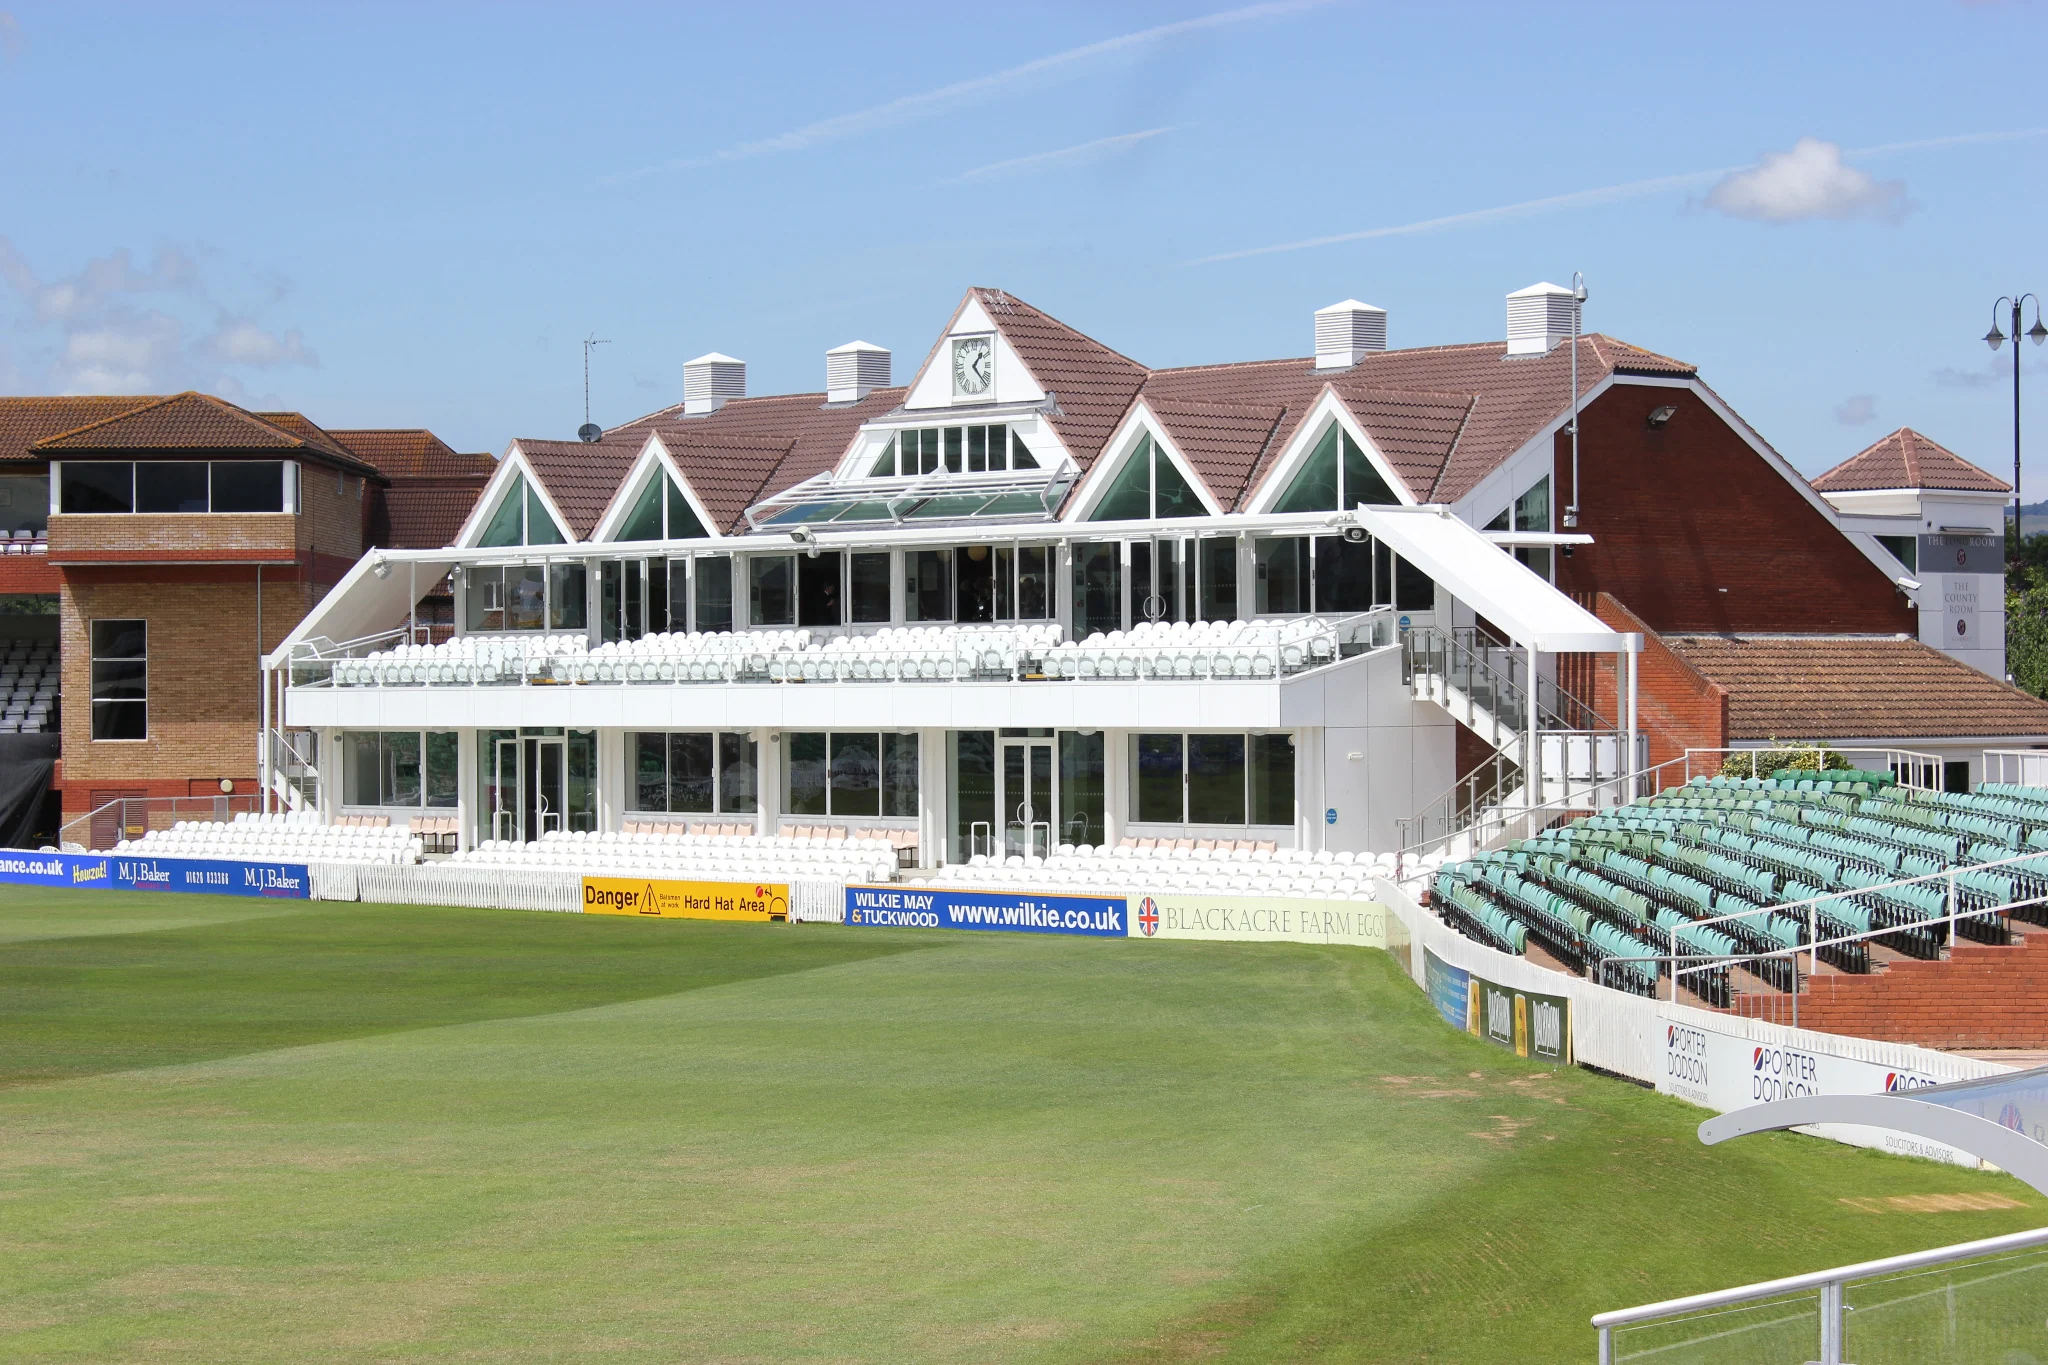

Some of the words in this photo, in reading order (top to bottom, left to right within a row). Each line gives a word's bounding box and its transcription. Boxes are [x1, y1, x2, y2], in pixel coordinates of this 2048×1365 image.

[1927, 536, 1944, 546] THE
[1969, 537, 1996, 547] ROOM
[1944, 593, 1977, 603] COUNTY
[1953, 582, 1969, 591] THE
[1949, 605, 1973, 614] ROOM
[118, 861, 170, 884] M.J.Baker
[244, 867, 300, 891] M.J.Baker
[585, 885, 640, 910] Danger
[659, 893, 681, 901] Batsmen
[684, 895, 710, 910] Hard
[715, 896, 734, 911] Hat
[739, 897, 765, 912] Area
[855, 893, 901, 909] WILKIE
[904, 895, 934, 910] MAY
[948, 902, 1122, 931] www.wilkie.co.uk
[1165, 907, 1291, 933] BLACKACRE
[1300, 911, 1351, 935] FARM
[1357, 913, 1384, 939] EGGS
[1675, 1027, 1707, 1058] PORTER
[1668, 1051, 1708, 1086] DODSON
[1764, 1048, 1818, 1082] PORTER
[1885, 1135, 1918, 1154] SOLICITORS
[1919, 1145, 1924, 1156] &
[1924, 1144, 1954, 1162] ADVISORS
